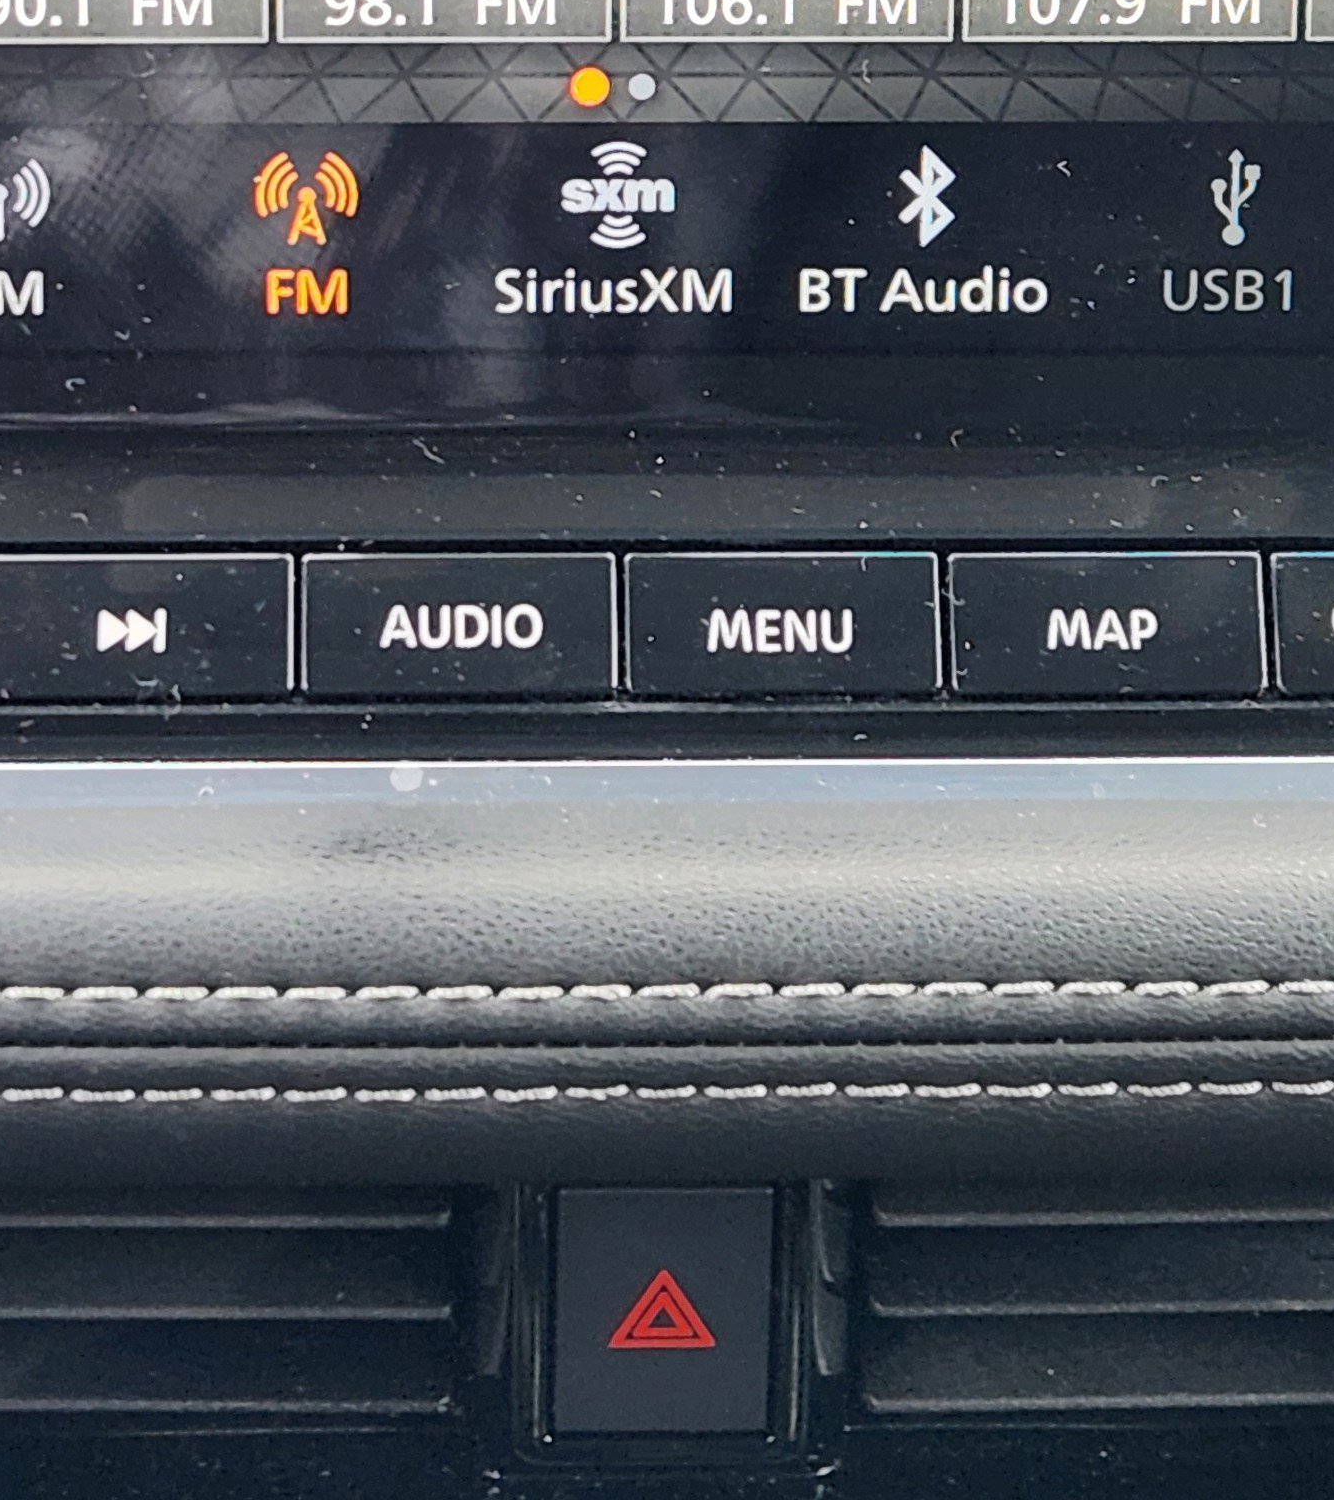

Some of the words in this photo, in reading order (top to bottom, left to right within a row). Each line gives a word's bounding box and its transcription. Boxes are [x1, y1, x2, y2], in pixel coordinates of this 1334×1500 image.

[560, 174, 677, 213] sxm
[264, 267, 349, 316] FM
[493, 265, 734, 315] SiriusXM
[798, 267, 869, 314] BT
[878, 264, 1049, 314] Audio
[1162, 267, 1293, 312] USB1
[378, 602, 545, 650] AUDIO
[705, 607, 854, 655] MENU
[1046, 607, 1159, 652] MAP
